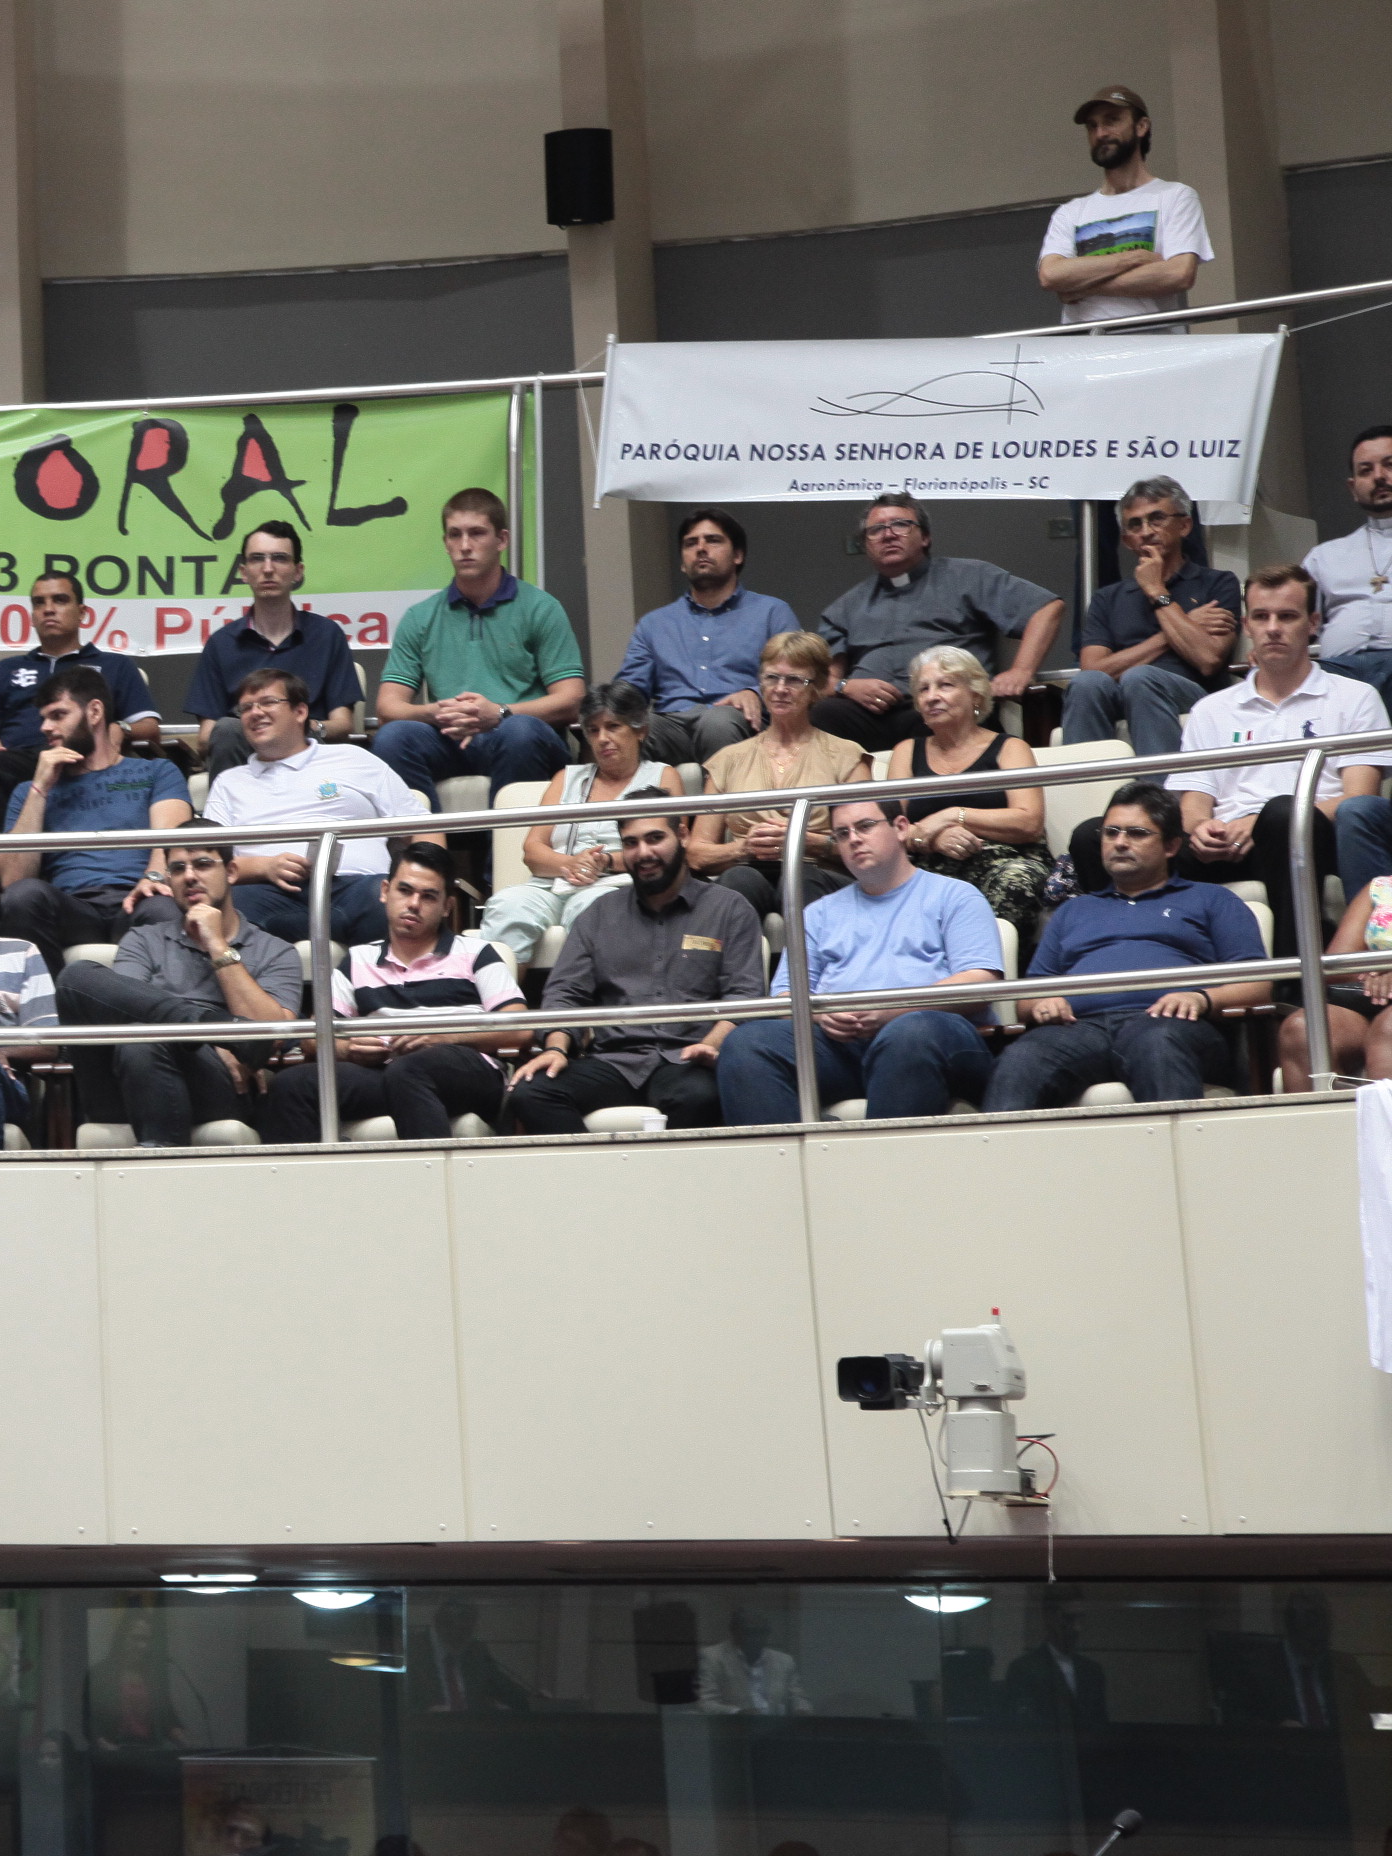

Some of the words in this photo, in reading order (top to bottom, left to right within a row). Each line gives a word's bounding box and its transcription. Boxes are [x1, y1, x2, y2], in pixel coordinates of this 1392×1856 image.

[620, 438, 740, 461] PARÓQUIA
[749, 443, 826, 462] NOSSA
[834, 442, 946, 461] SENHORA
[954, 441, 983, 459] DE
[991, 440, 1097, 459] LOURDES
[1106, 440, 1119, 458] E
[1126, 435, 1180, 458] SÃO
[1188, 439, 1242, 458] LUIZ
[904, 475, 1007, 493] Florianópolis
[1029, 476, 1050, 490] SC
[45, 553, 305, 596] PONTA
